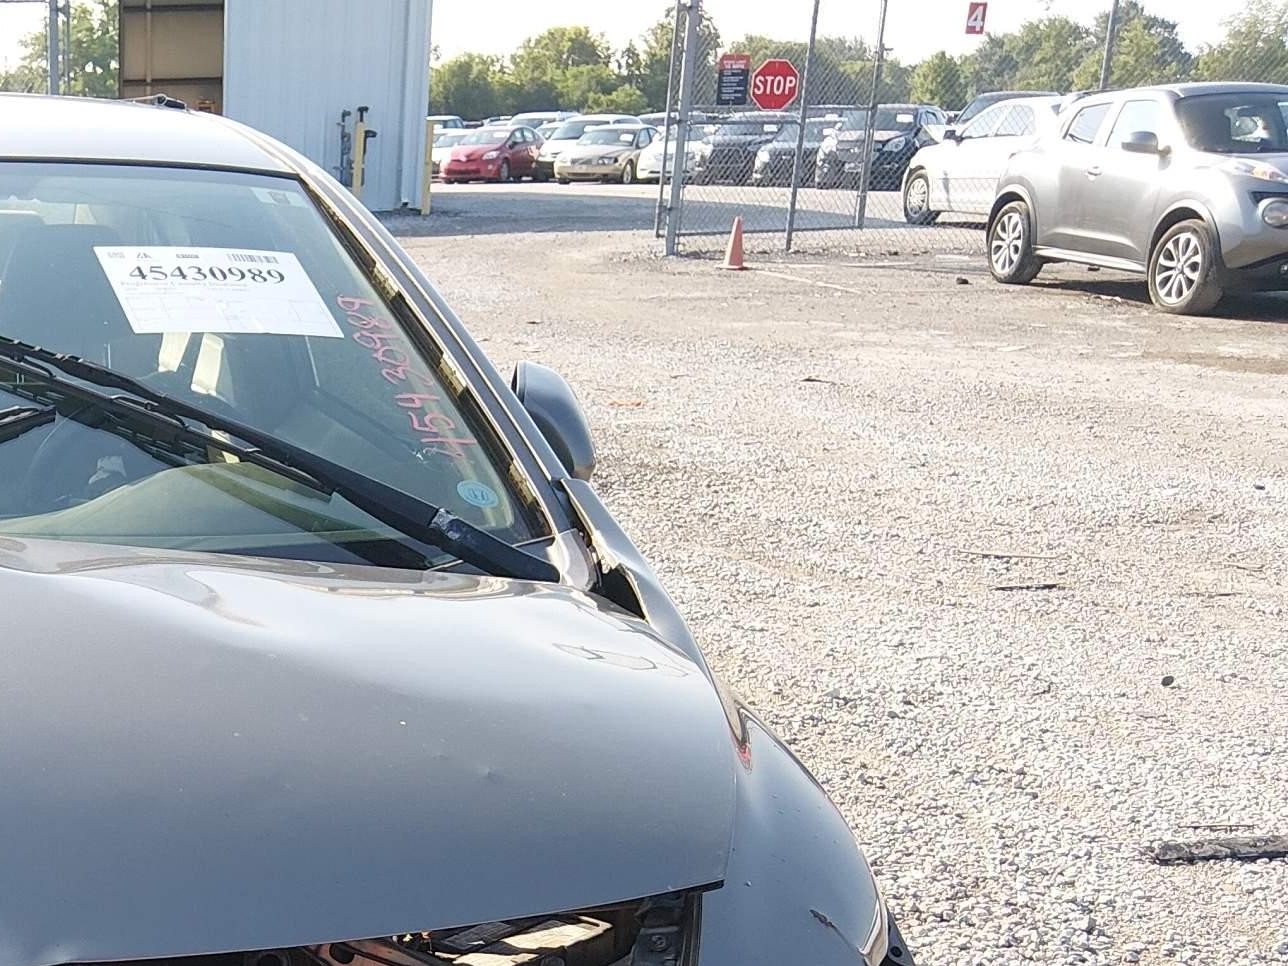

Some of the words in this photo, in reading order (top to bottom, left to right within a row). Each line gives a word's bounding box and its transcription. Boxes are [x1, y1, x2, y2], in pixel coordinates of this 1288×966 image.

[967, 5, 985, 33] 4
[754, 75, 796, 95] STOP
[128, 265, 286, 284] 45430989
